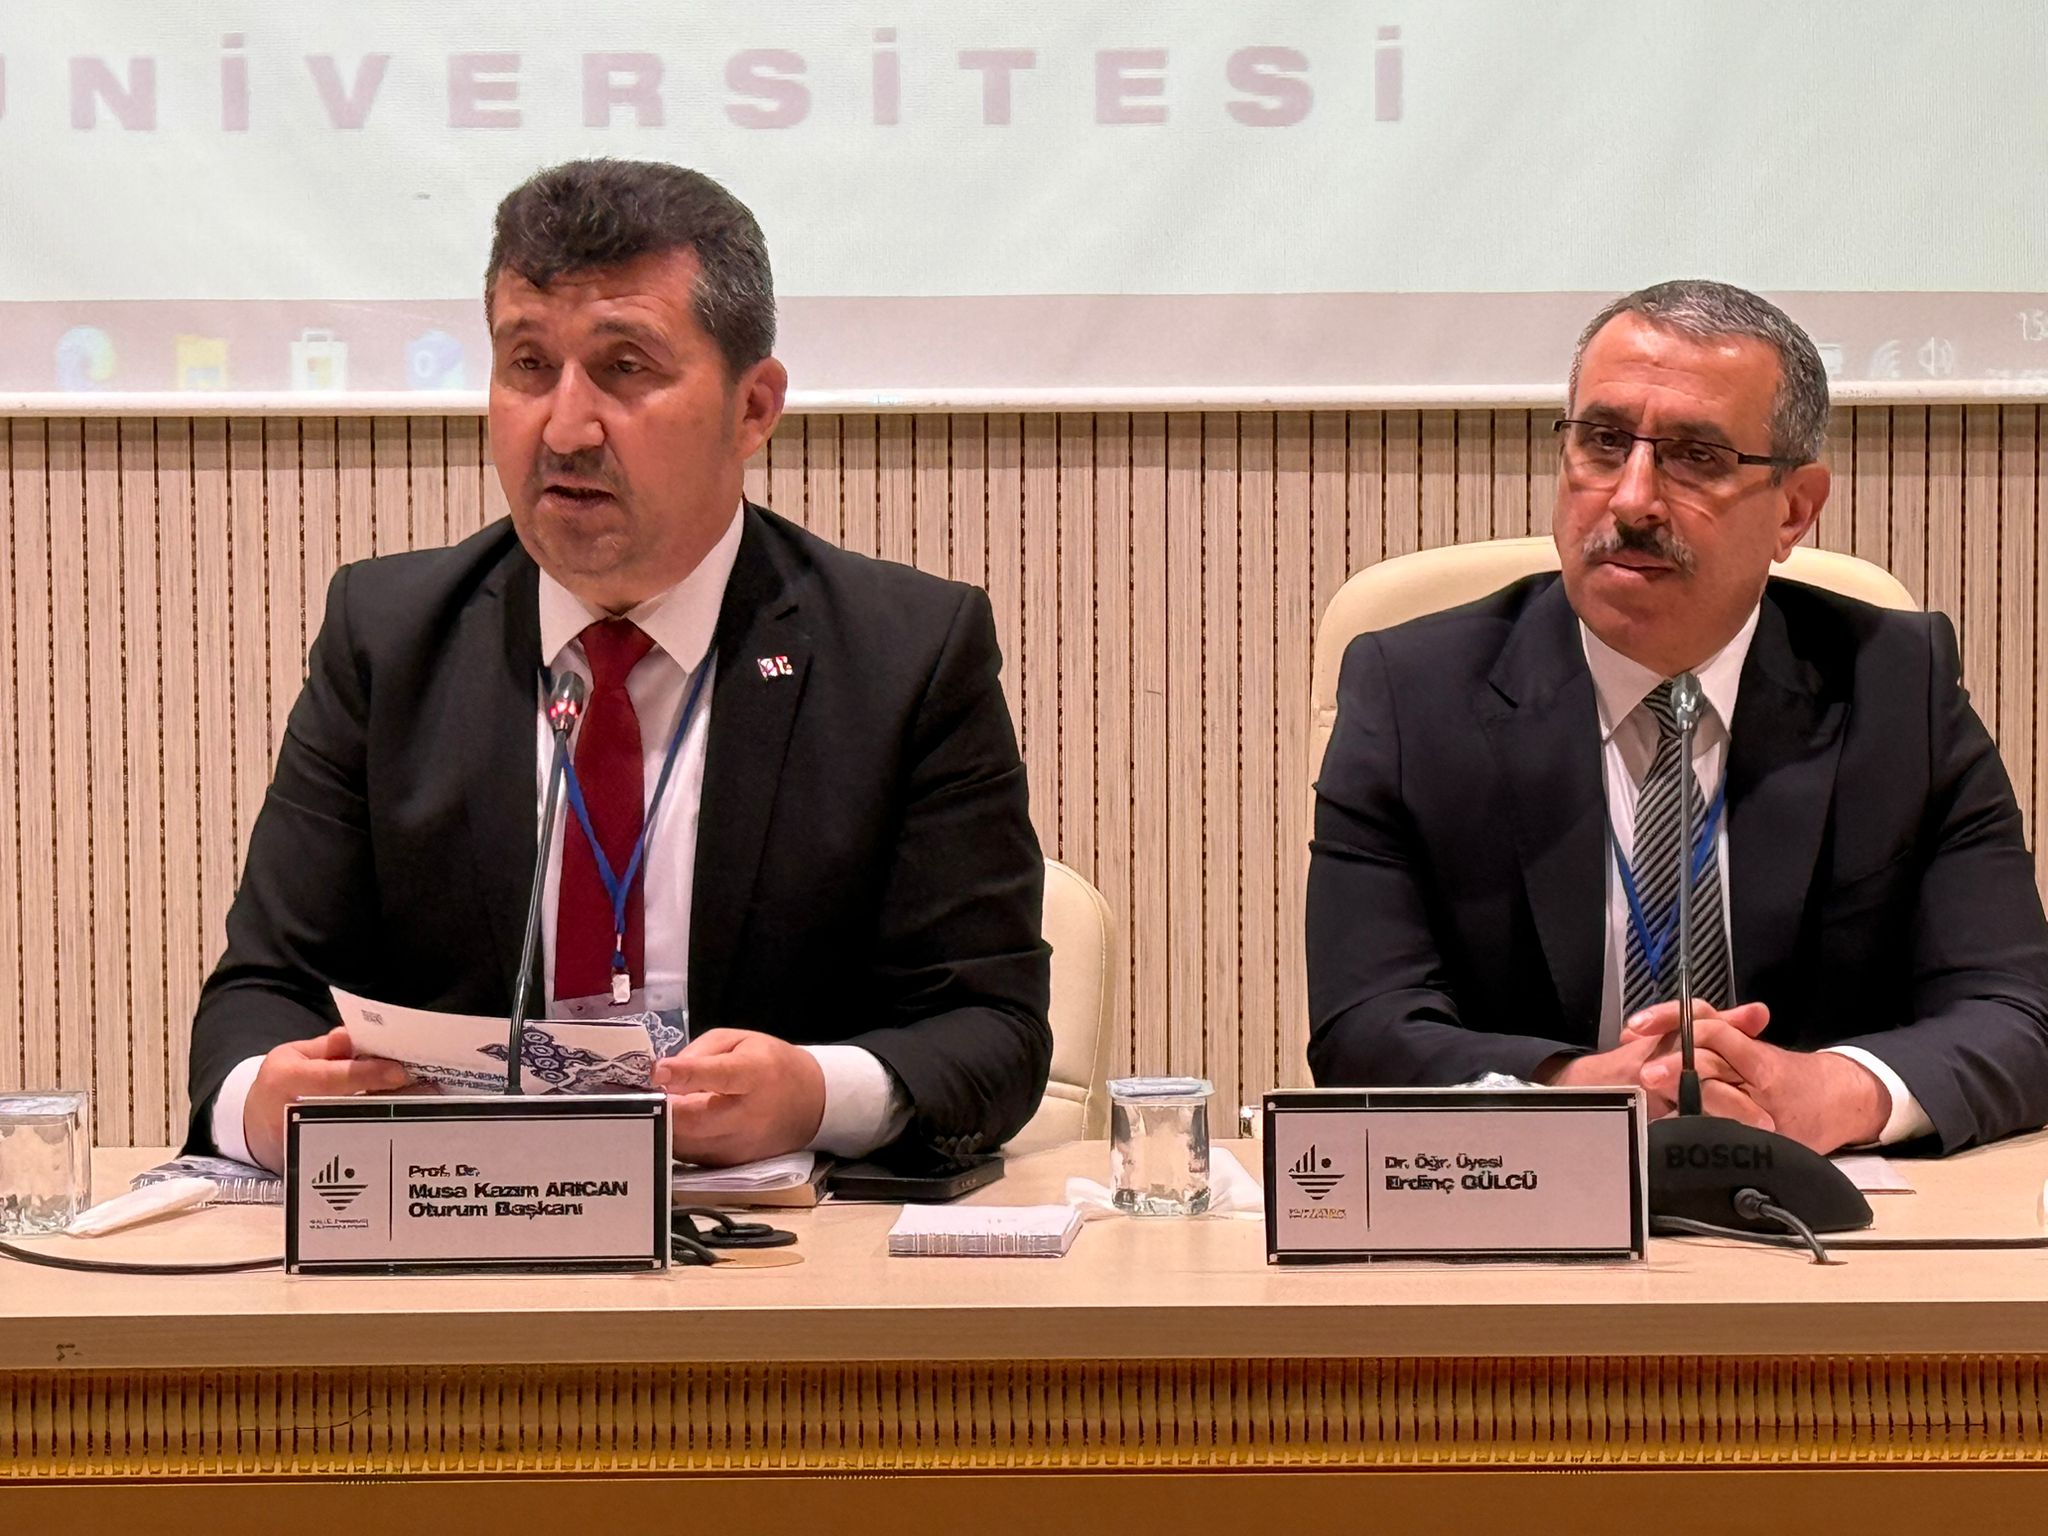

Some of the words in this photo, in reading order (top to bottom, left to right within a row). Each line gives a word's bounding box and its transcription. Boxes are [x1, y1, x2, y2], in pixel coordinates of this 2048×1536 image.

[0, 26, 1405, 132] NİVERSİTESİ
[1385, 1156, 1410, 1169] Dr.
[1456, 1153, 1503, 1171] Üyesi
[1665, 1143, 1774, 1169] BOSCH
[408, 1164, 451, 1178] Prof.
[1461, 1170, 1538, 1190] GÜLCÜ
[409, 1183, 468, 1199] Musa
[408, 1202, 488, 1218] Oturum
[495, 1200, 583, 1220] Başkanı
